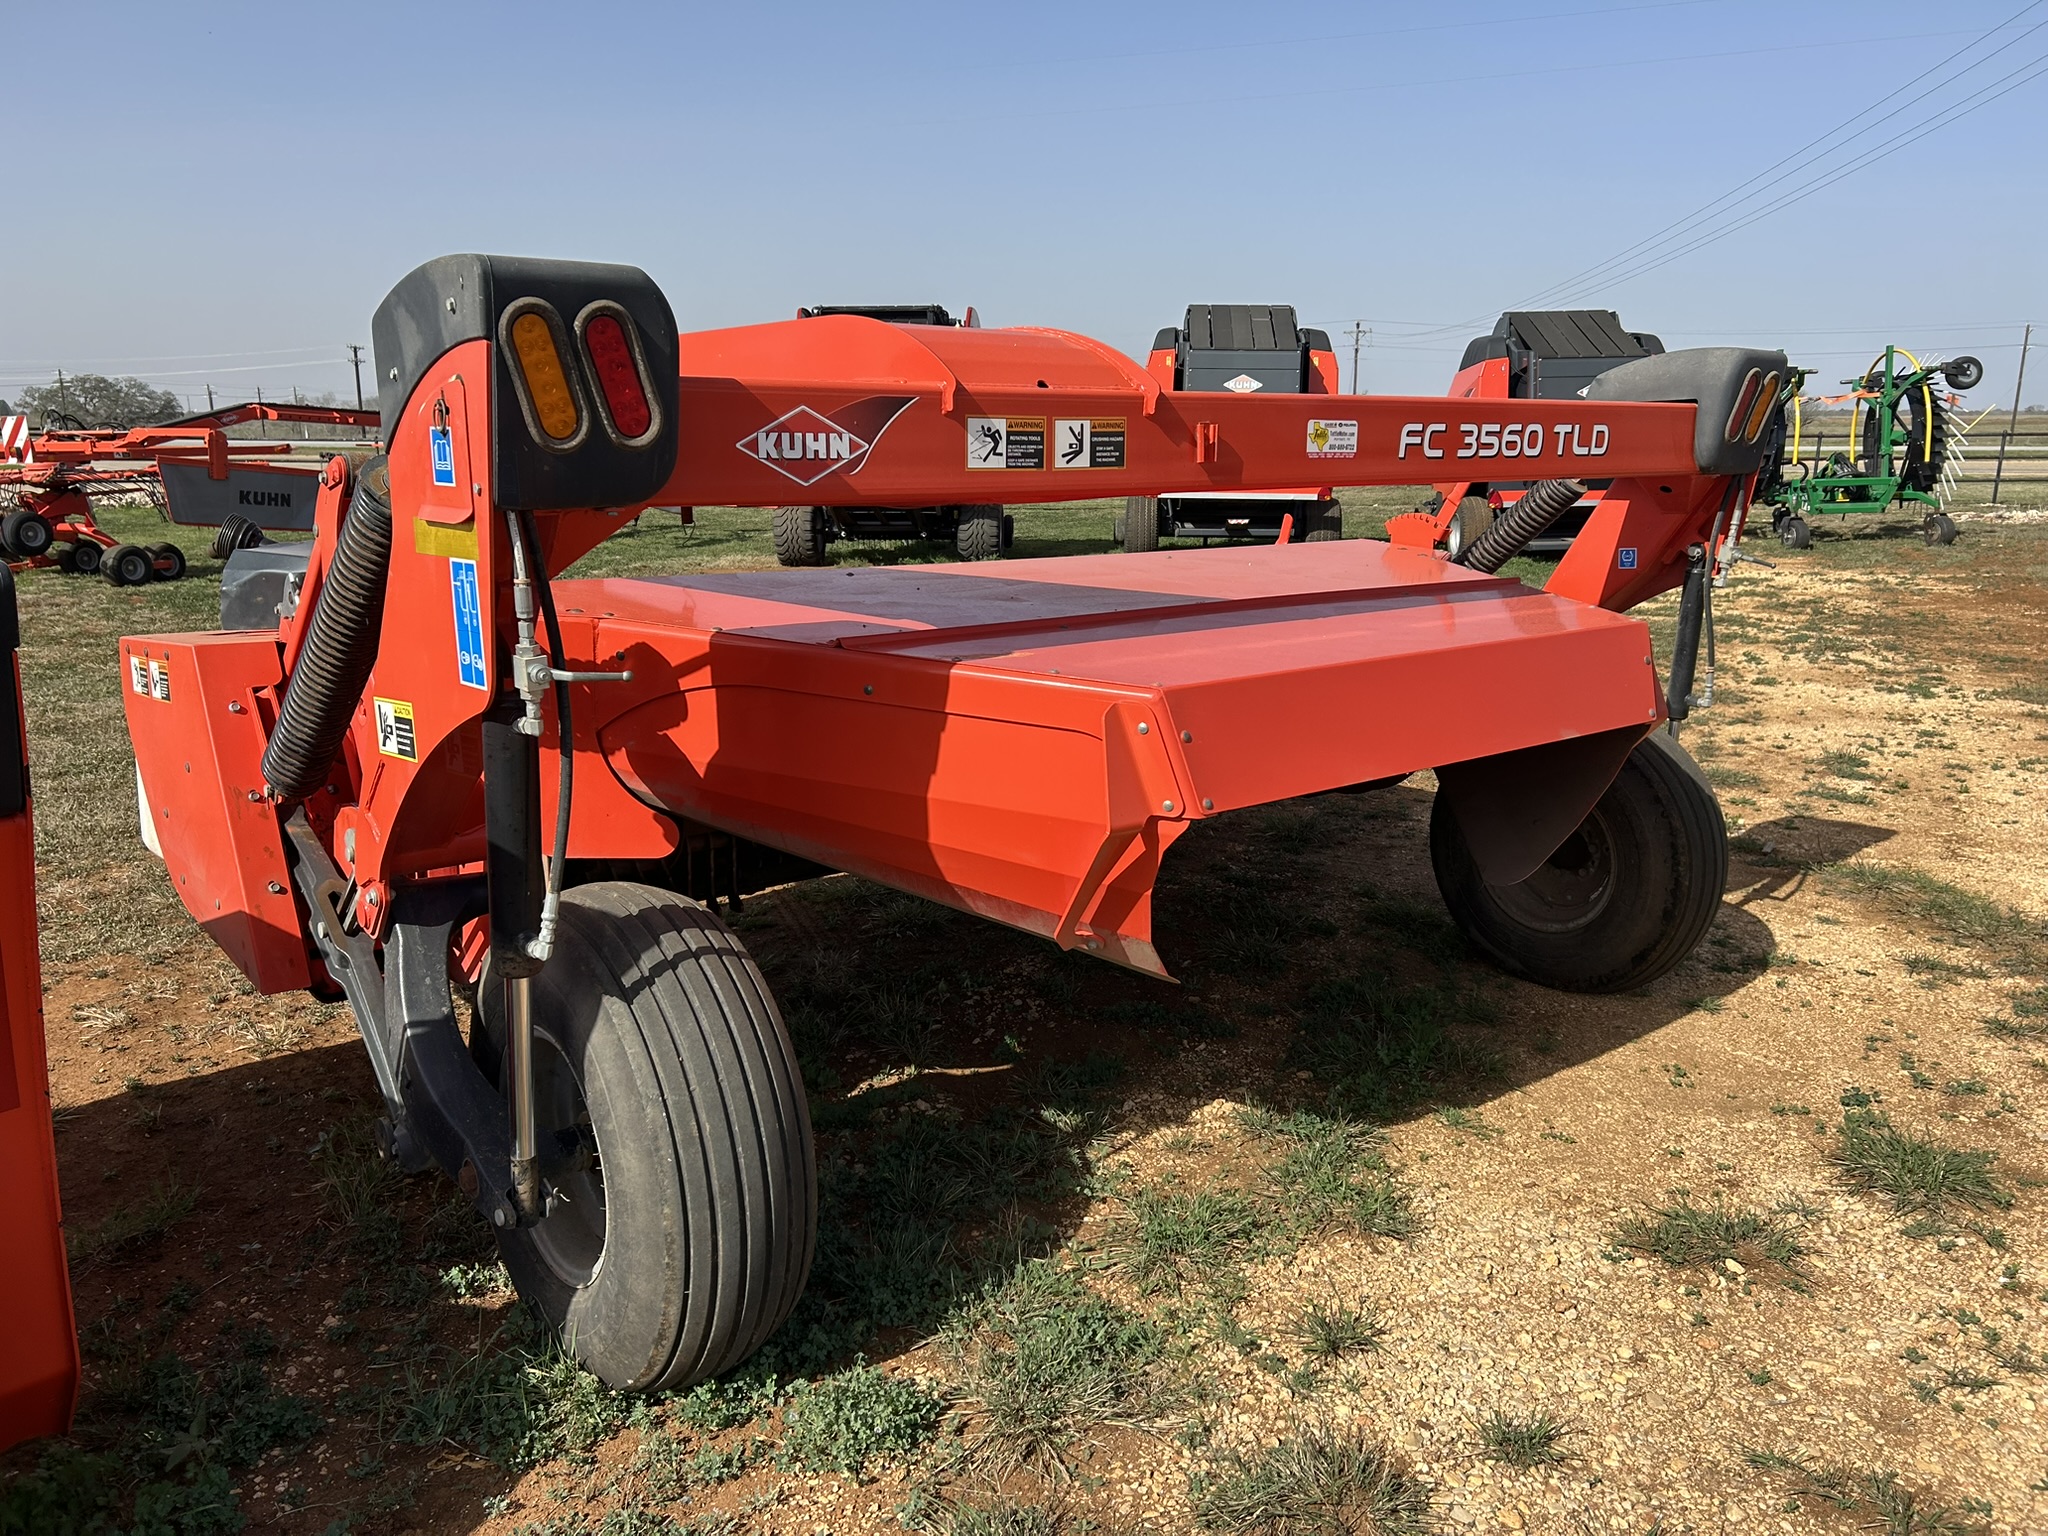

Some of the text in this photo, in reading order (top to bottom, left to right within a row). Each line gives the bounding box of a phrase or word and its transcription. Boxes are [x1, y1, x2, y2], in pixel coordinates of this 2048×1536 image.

[1229, 380, 1257, 389] KUHN
[1013, 421, 1043, 429] WARNING
[1097, 422, 1124, 430] WARNING
[757, 432, 850, 459] KUHN
[1398, 423, 1610, 459] FC 3560 TLD
[239, 490, 291, 507] KUHN
